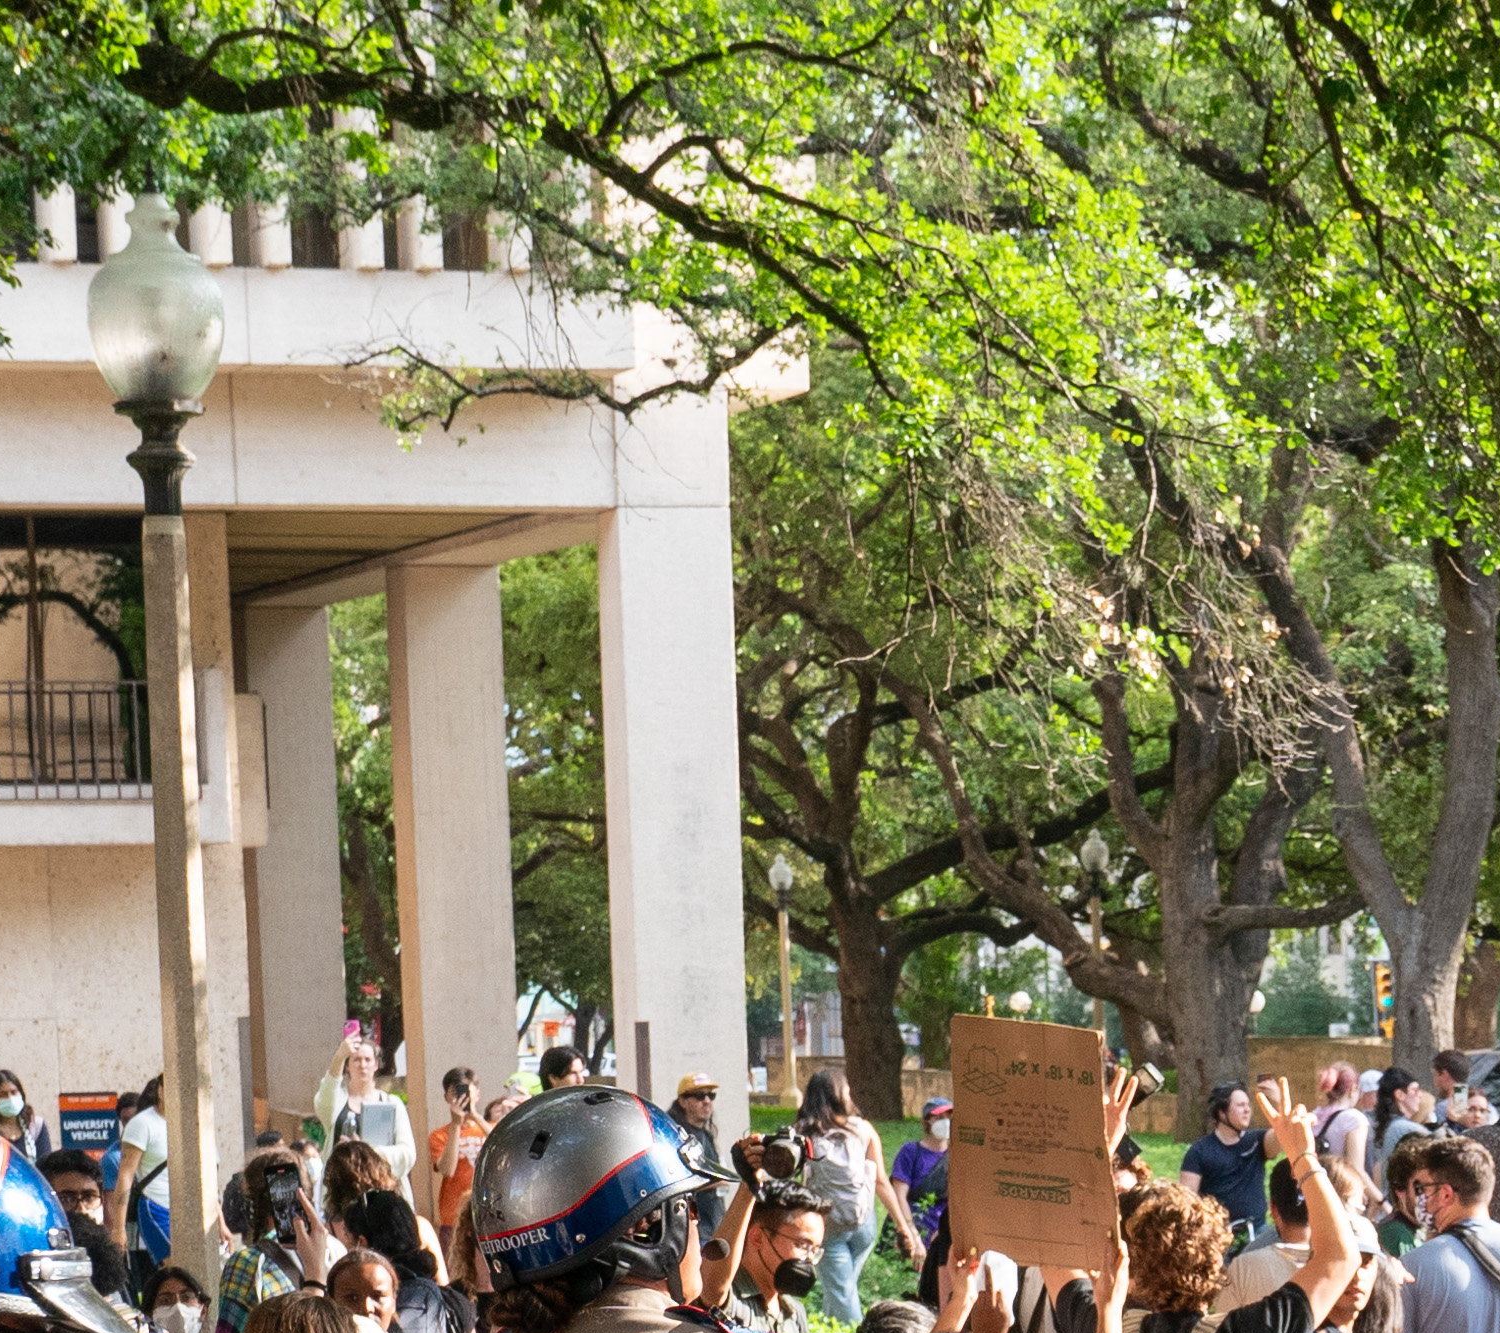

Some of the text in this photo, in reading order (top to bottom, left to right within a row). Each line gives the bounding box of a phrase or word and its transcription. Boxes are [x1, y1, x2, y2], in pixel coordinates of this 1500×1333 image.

[63, 1118, 116, 1130] UNIVERSITY
[71, 1131, 109, 1142] VEHICLE
[1000, 1187, 1071, 1204] MENARDS
[488, 1227, 551, 1254] TROOPER
